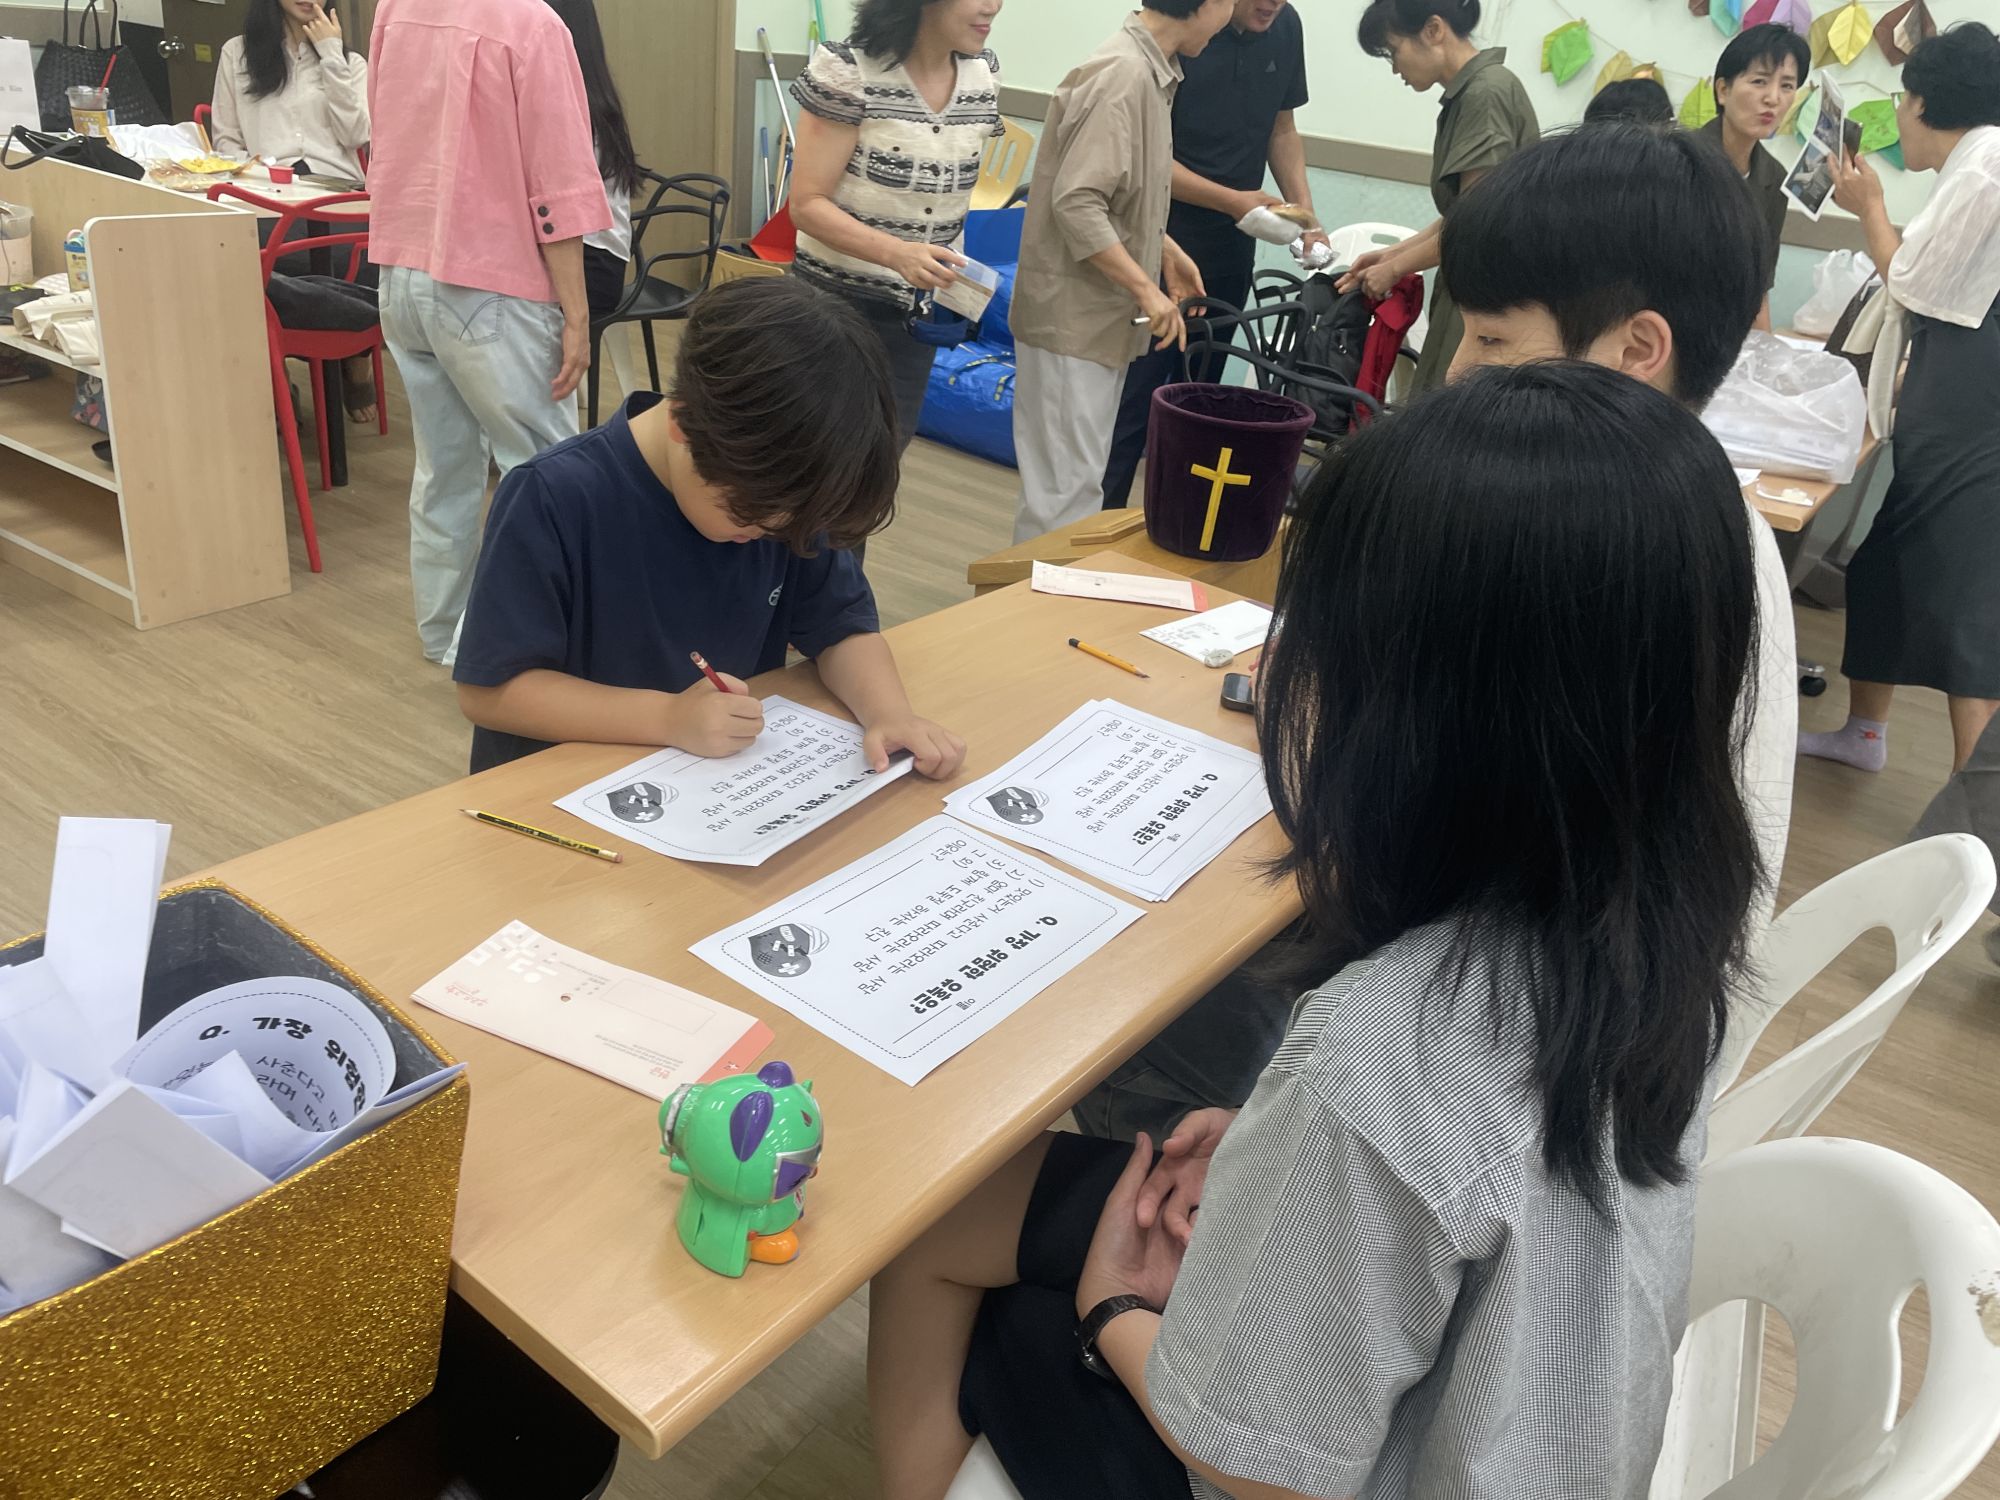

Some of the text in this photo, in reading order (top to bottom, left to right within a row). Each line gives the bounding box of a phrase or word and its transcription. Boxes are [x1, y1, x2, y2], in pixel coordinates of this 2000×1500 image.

[930, 839, 968, 862] 이유는?
[952, 849, 987, 869] 그 외)
[864, 858, 1007, 943] 3) 함께 도둑질 하자는 친구
[986, 887, 1033, 914] 맛있는거
[852, 868, 1025, 974] 2) 엄마 친구라며 따라오라는 사람
[945, 912, 989, 939] 사준다고
[887, 939, 948, 975] 따라오라는
[909, 916, 1058, 1015] Q. 가장 위험한 유혹은?
[857, 975, 888, 995] 사람
[955, 998, 976, 1011] 이름
[199, 1025, 231, 1041] Q.
[252, 1016, 313, 1040] 가장
[256, 1055, 326, 1101] 사준다고
